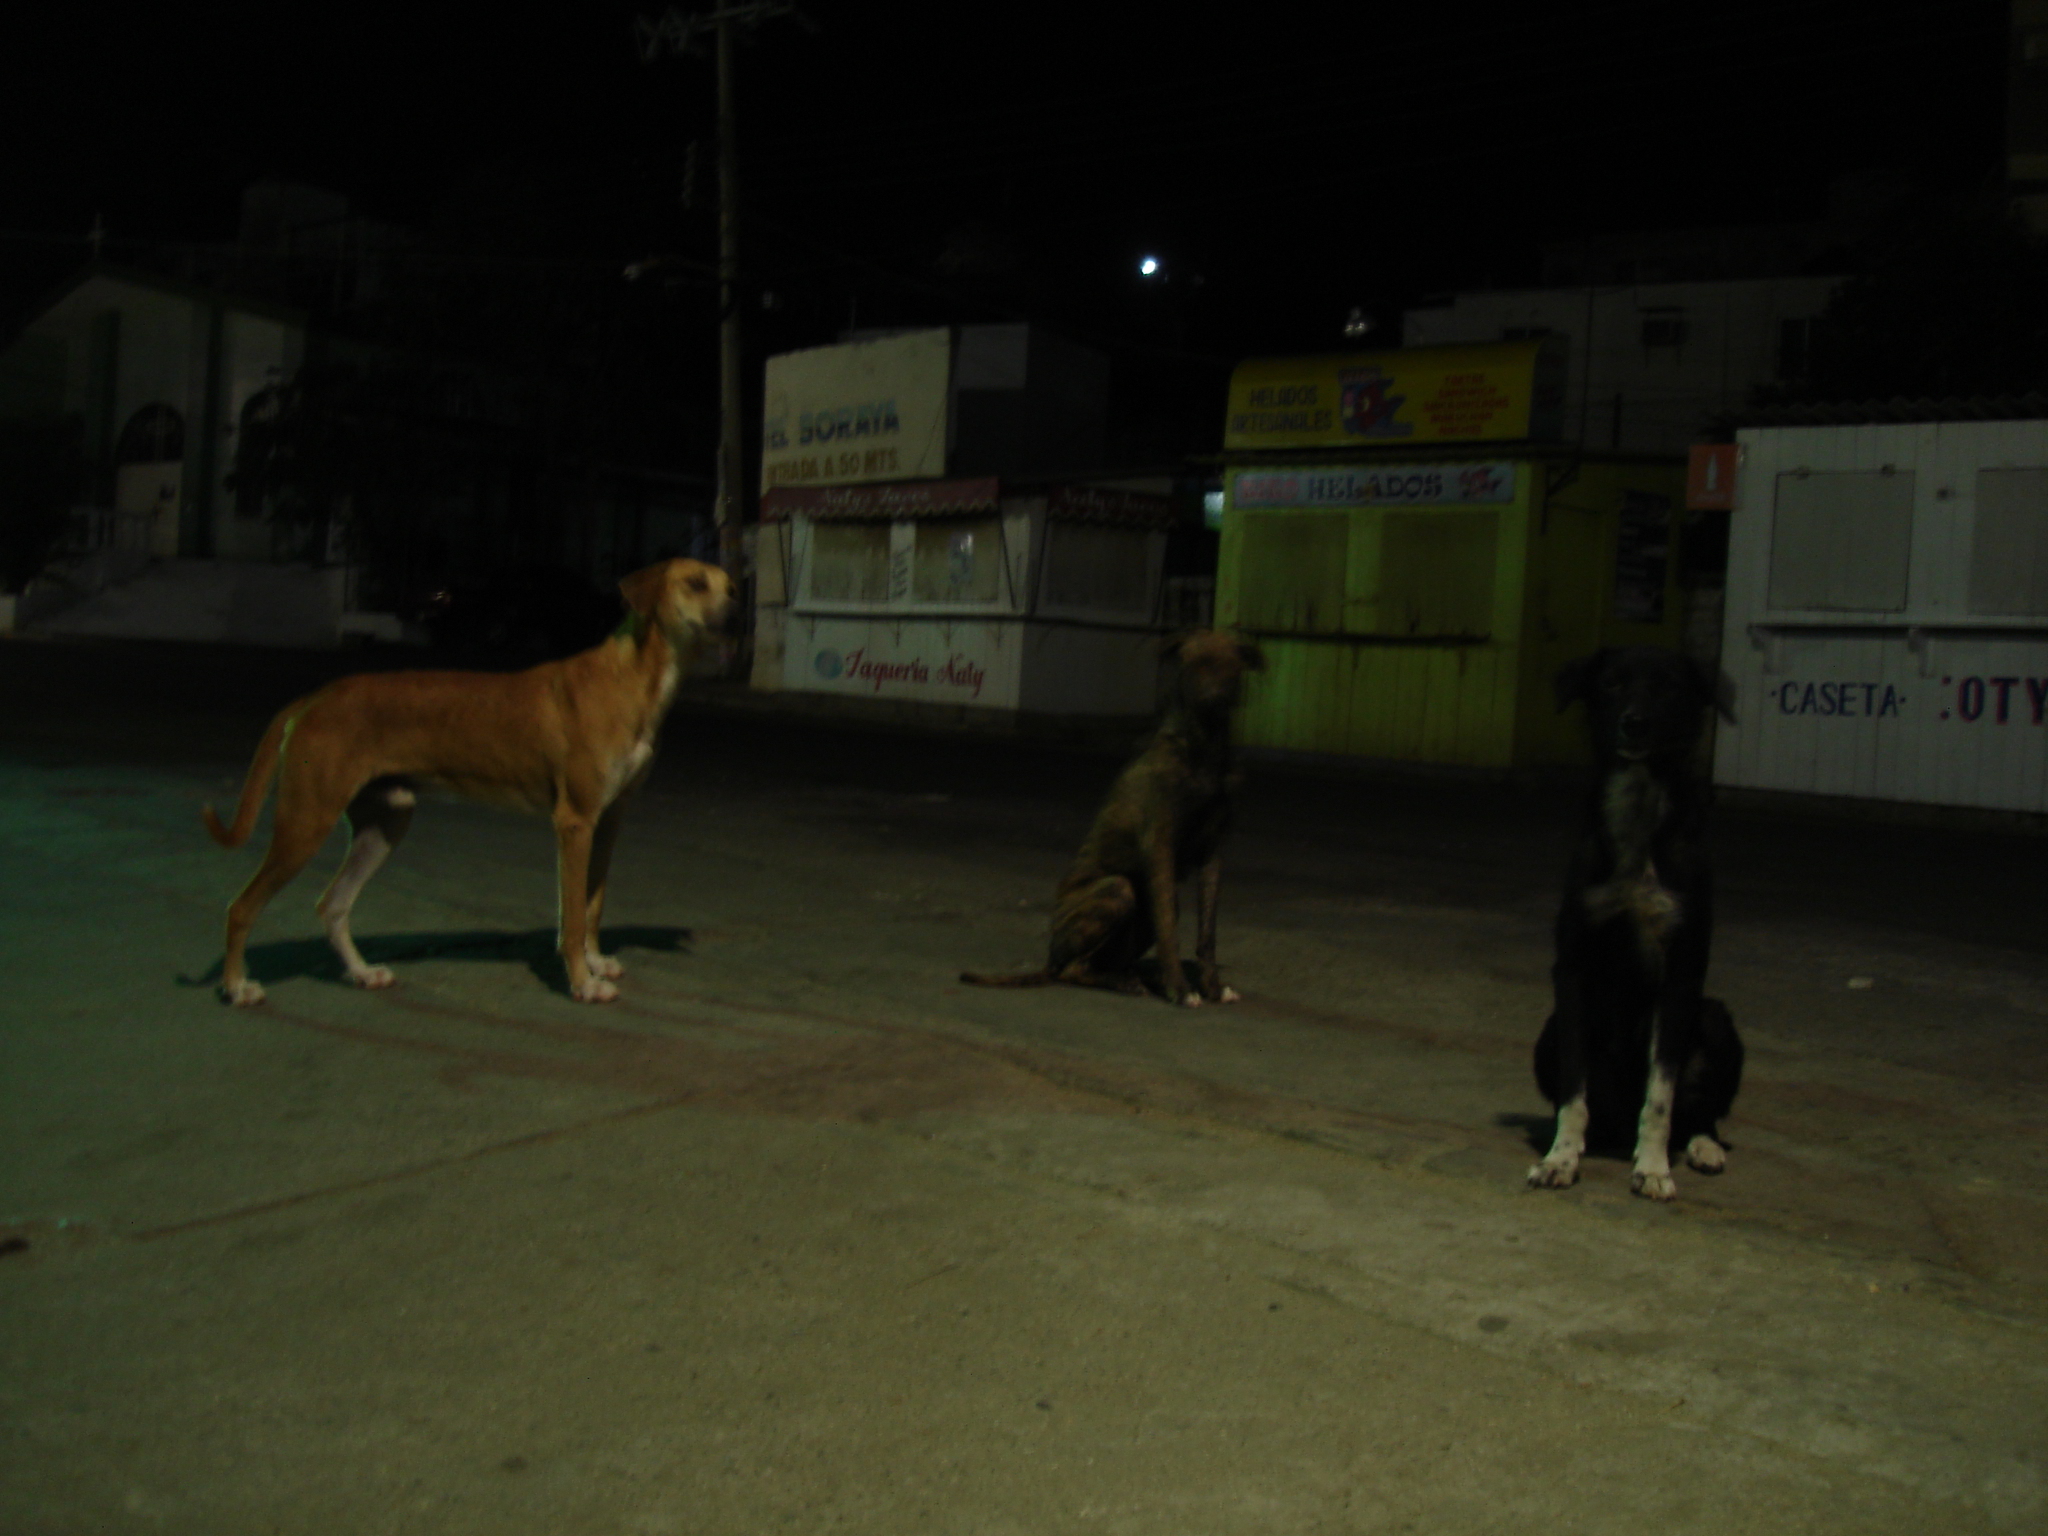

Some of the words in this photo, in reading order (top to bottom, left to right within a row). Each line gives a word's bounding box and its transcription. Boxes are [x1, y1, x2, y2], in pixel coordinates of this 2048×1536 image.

[800, 400, 900, 445] SORAYA
[838, 450, 861, 476] 50
[1307, 472, 1444, 502] HELADOS
[936, 653, 986, 699] Naty
